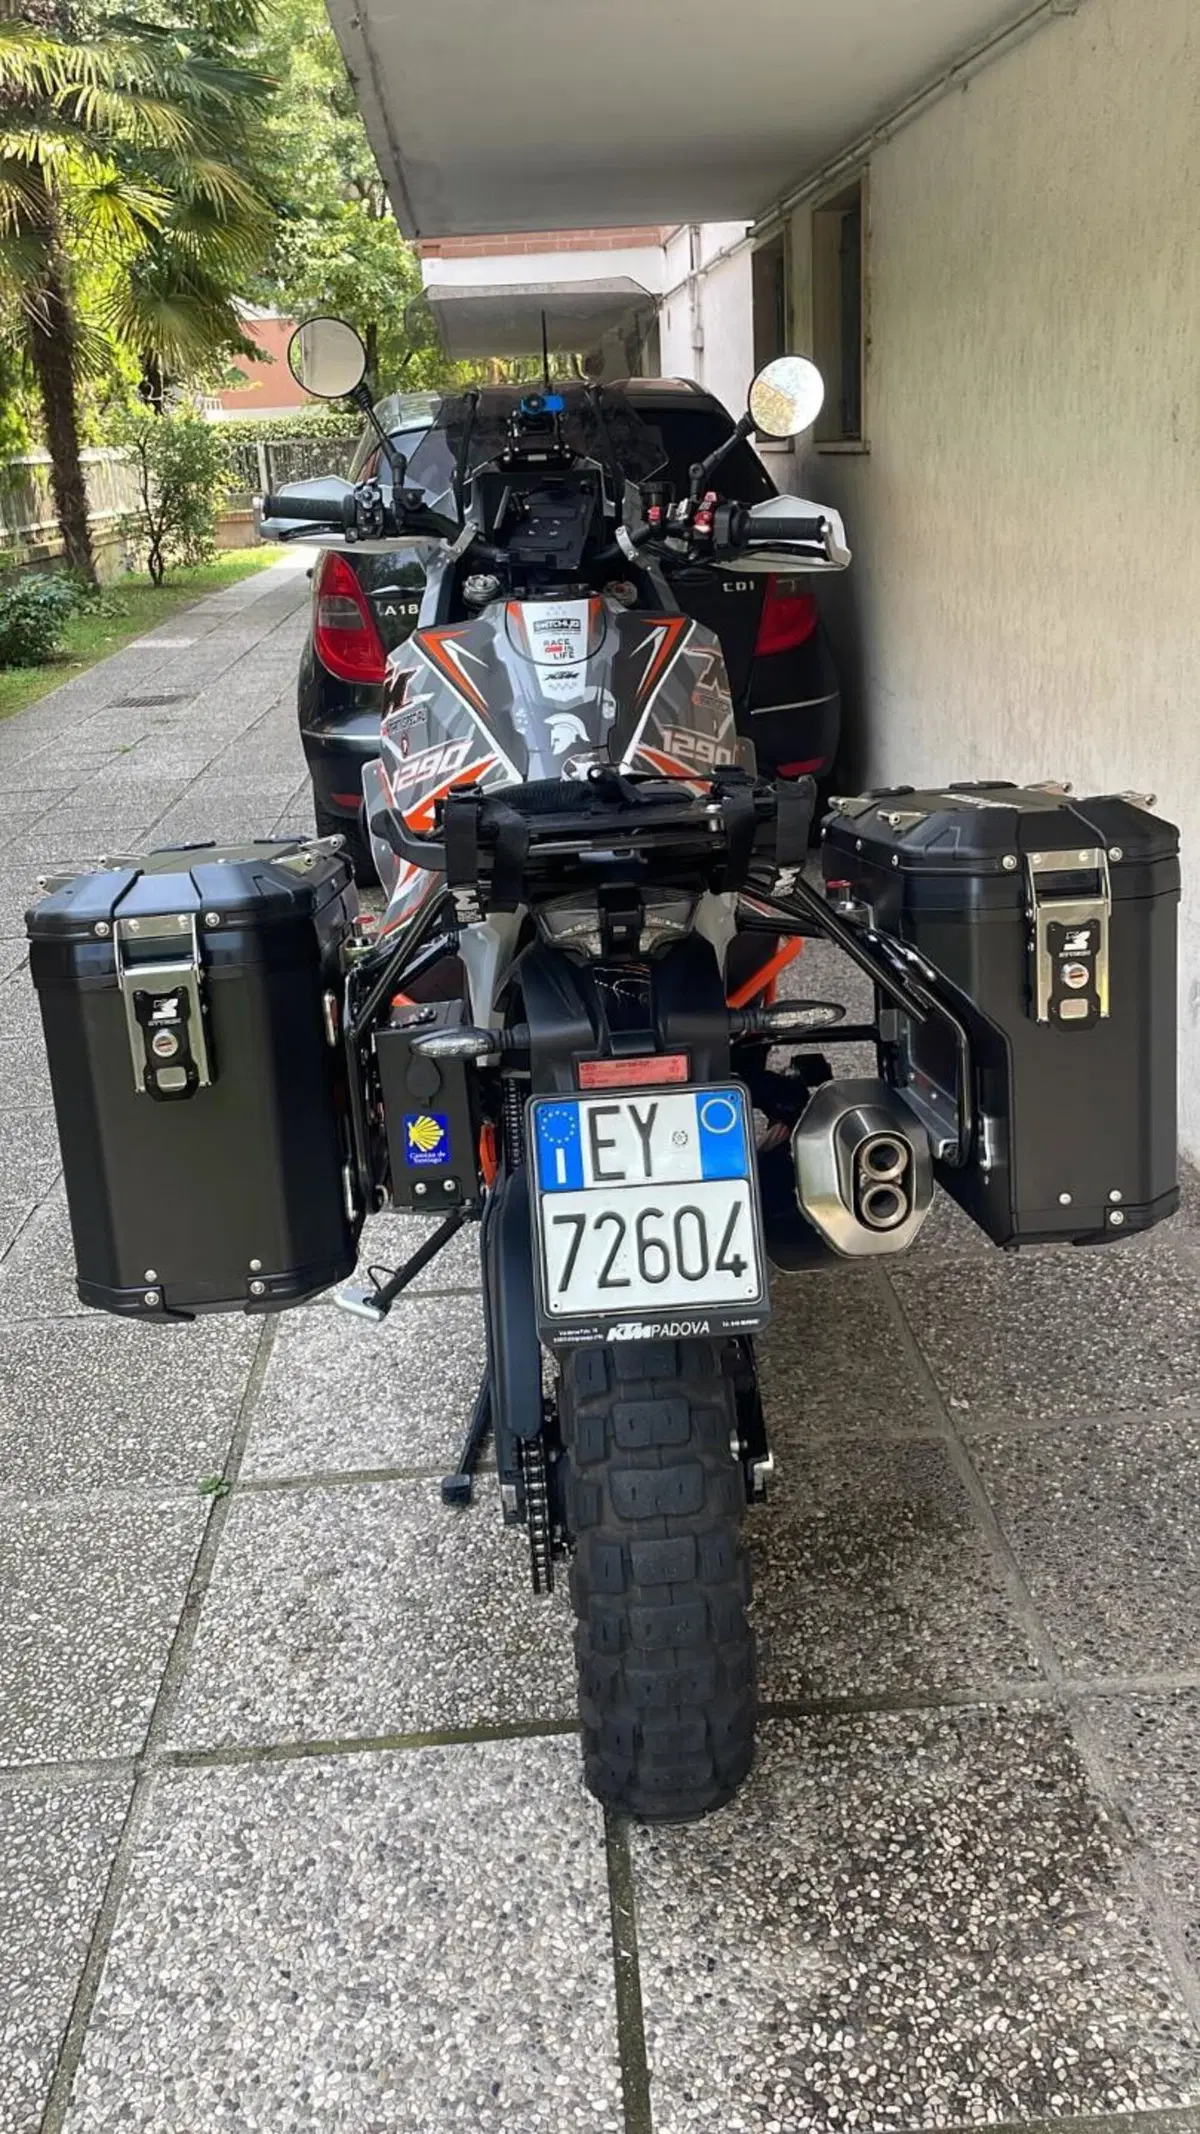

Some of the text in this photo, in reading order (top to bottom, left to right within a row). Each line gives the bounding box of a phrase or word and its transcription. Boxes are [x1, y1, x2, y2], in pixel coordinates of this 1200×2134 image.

[723, 580, 755, 592] CDI
[553, 651, 575, 659] LIFE
[587, 1102, 659, 1182] EY
[552, 1200, 748, 1293] 72604
[606, 1321, 651, 1342] KTM
[651, 1320, 711, 1338] PADOVA
